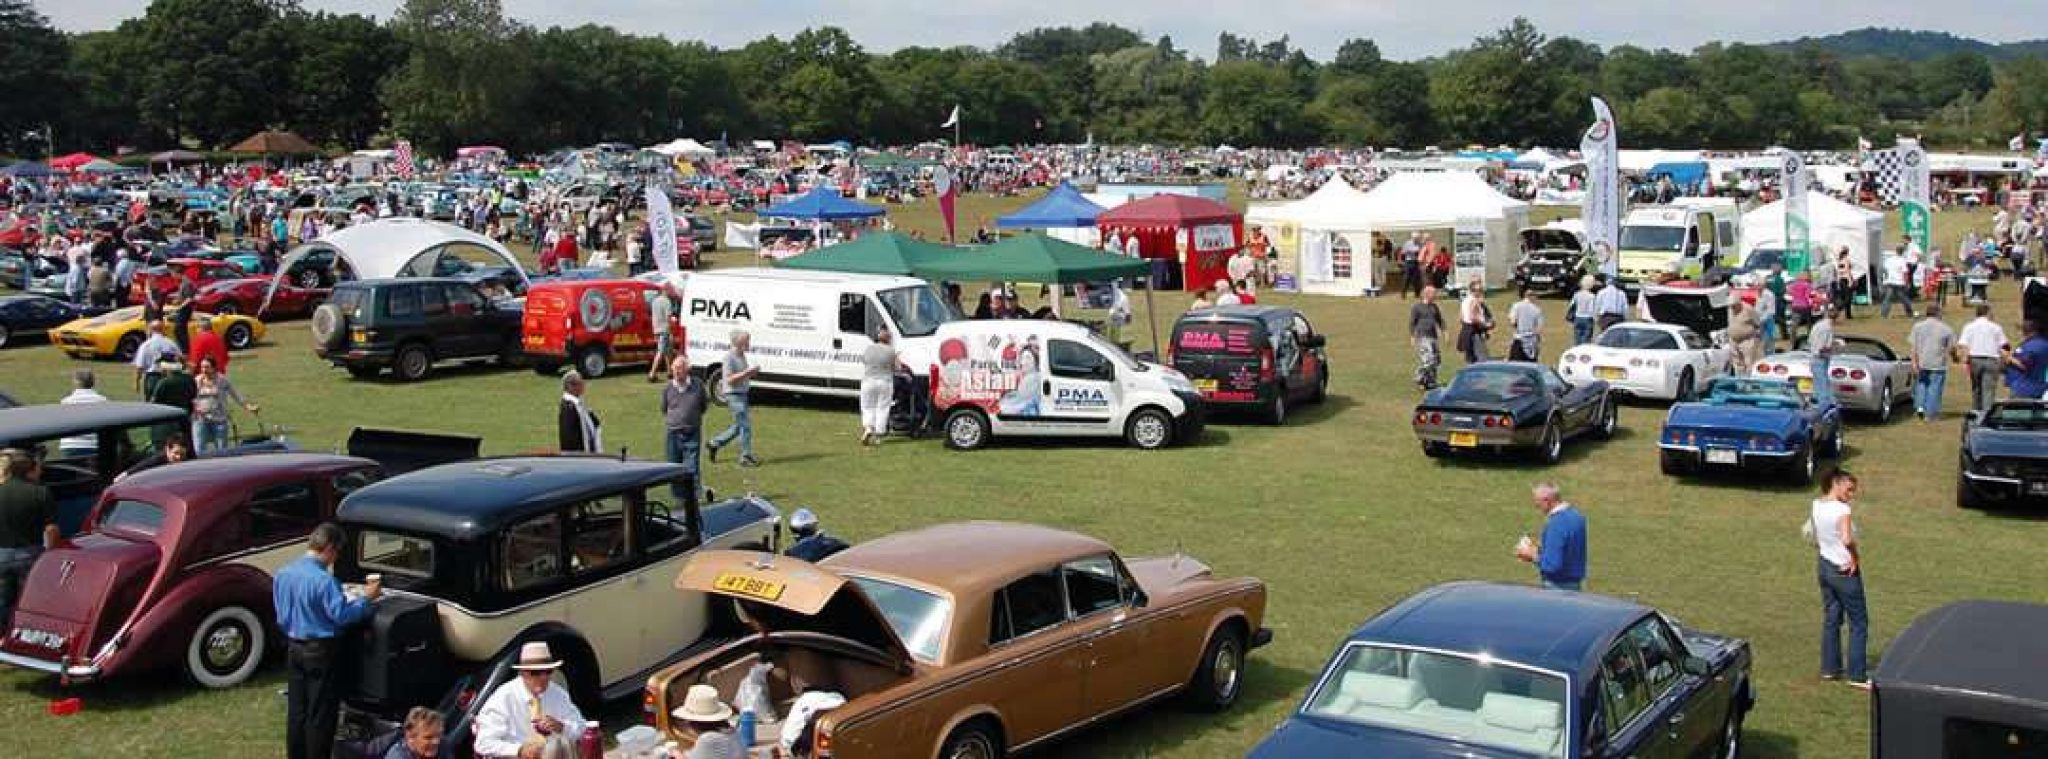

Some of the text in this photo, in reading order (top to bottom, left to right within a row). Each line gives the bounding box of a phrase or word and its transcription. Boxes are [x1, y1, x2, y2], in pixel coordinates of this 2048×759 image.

[690, 298, 752, 320] PMA
[961, 369, 1021, 391] Asian
[1058, 388, 1106, 400] PMA
